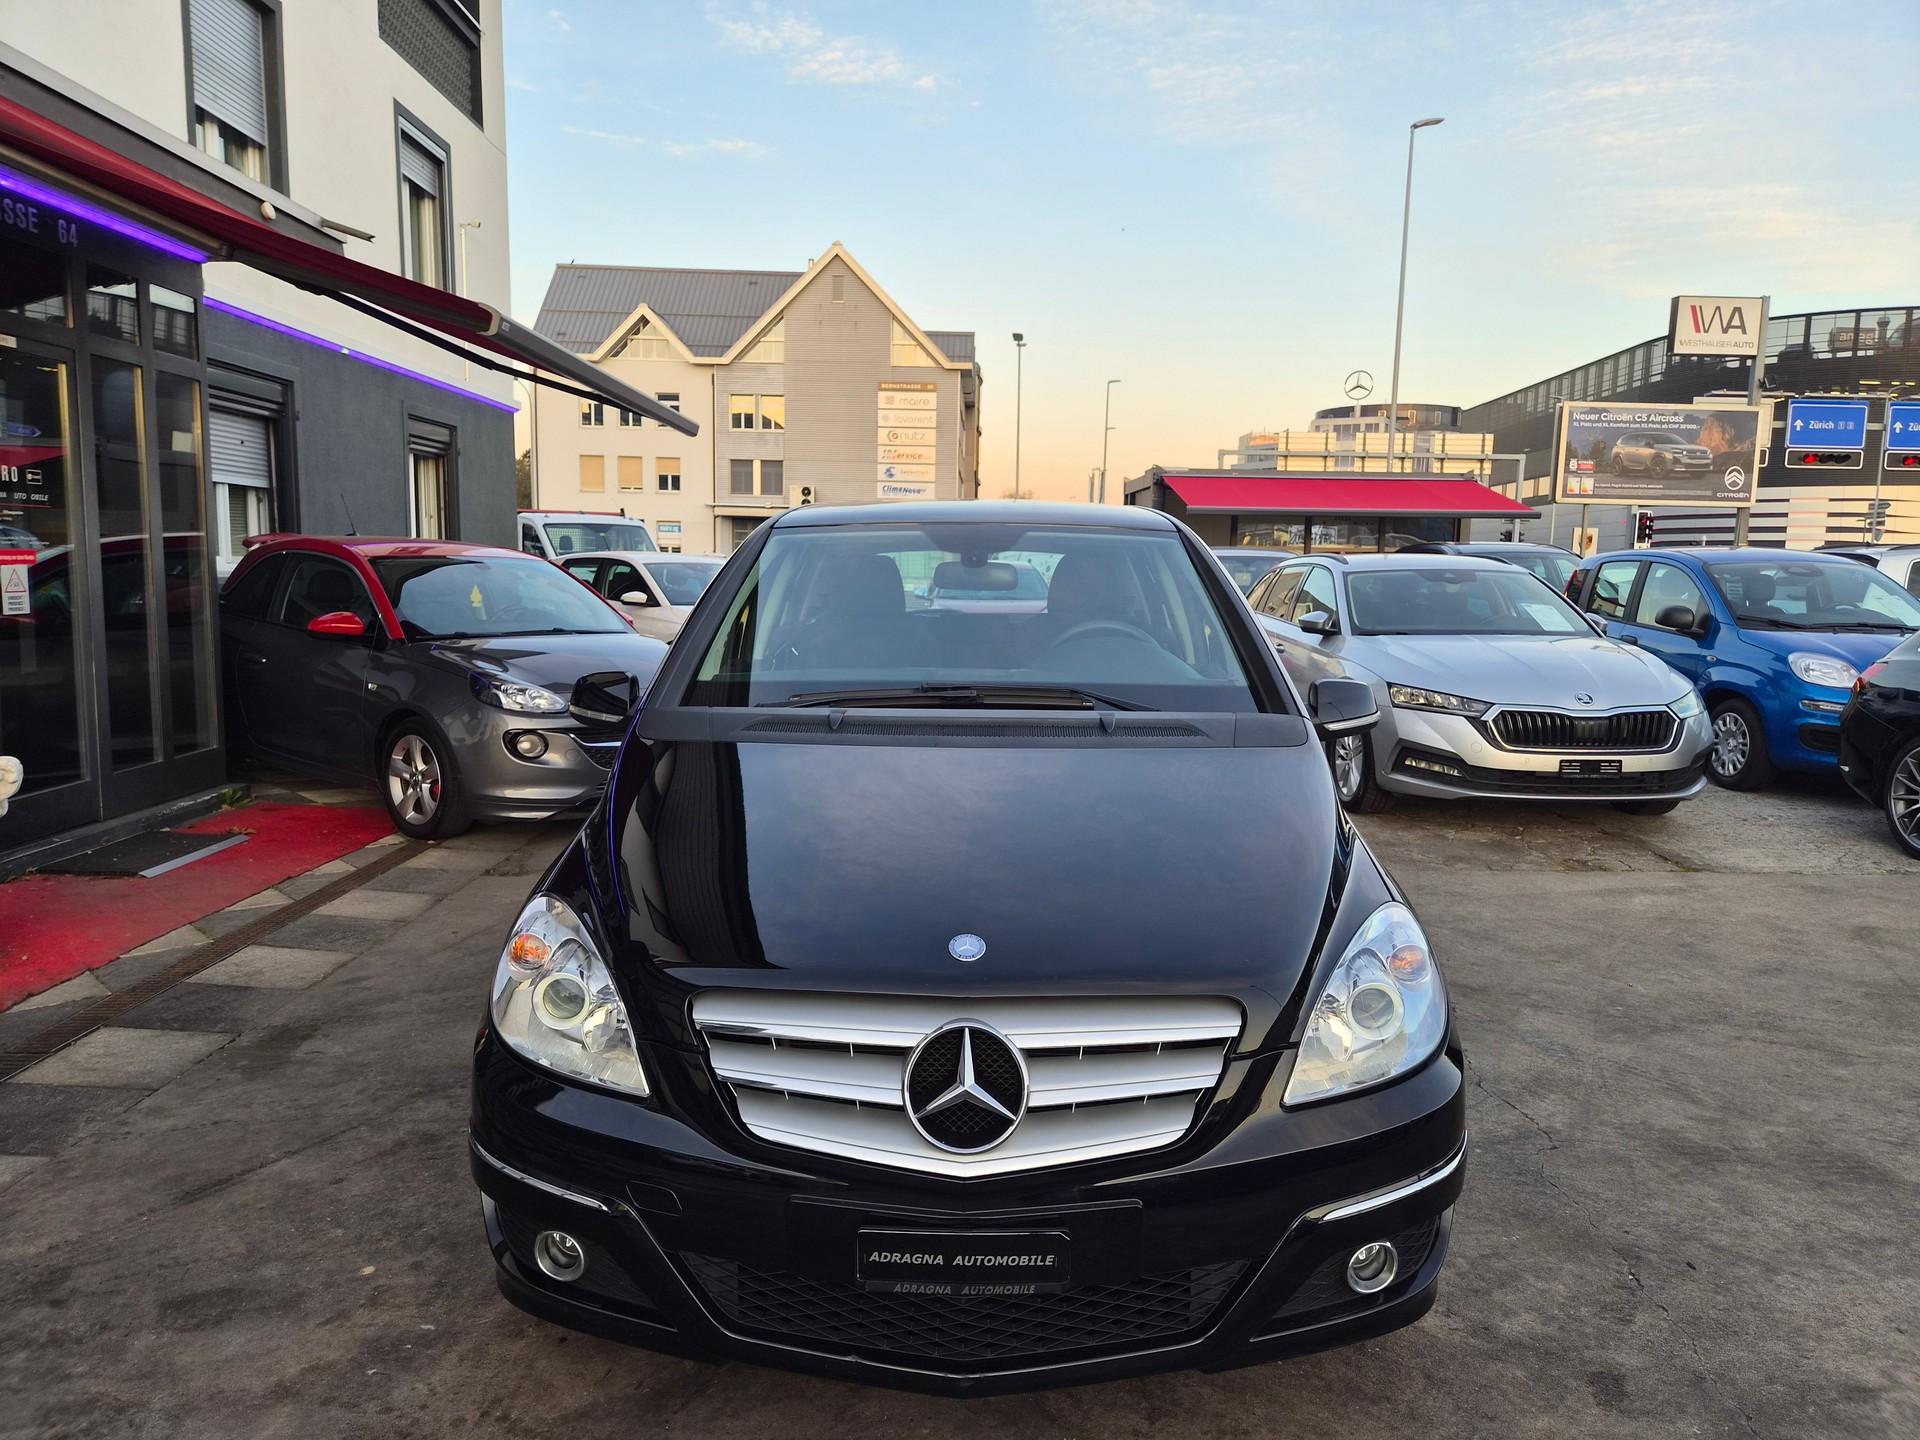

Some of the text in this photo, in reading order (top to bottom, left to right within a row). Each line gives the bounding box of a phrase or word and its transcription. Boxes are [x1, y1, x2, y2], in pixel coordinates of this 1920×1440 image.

[0, 198, 78, 247] SSE 64
[1573, 412, 1684, 423] Neuer Citroën C5 Aircross
[1809, 420, 1834, 430] Zürich
[869, 1252, 1055, 1266] ADRAGNA AUTOMOBILE
[894, 1284, 1035, 1295] ADRAGNA AUTOMOBILE
